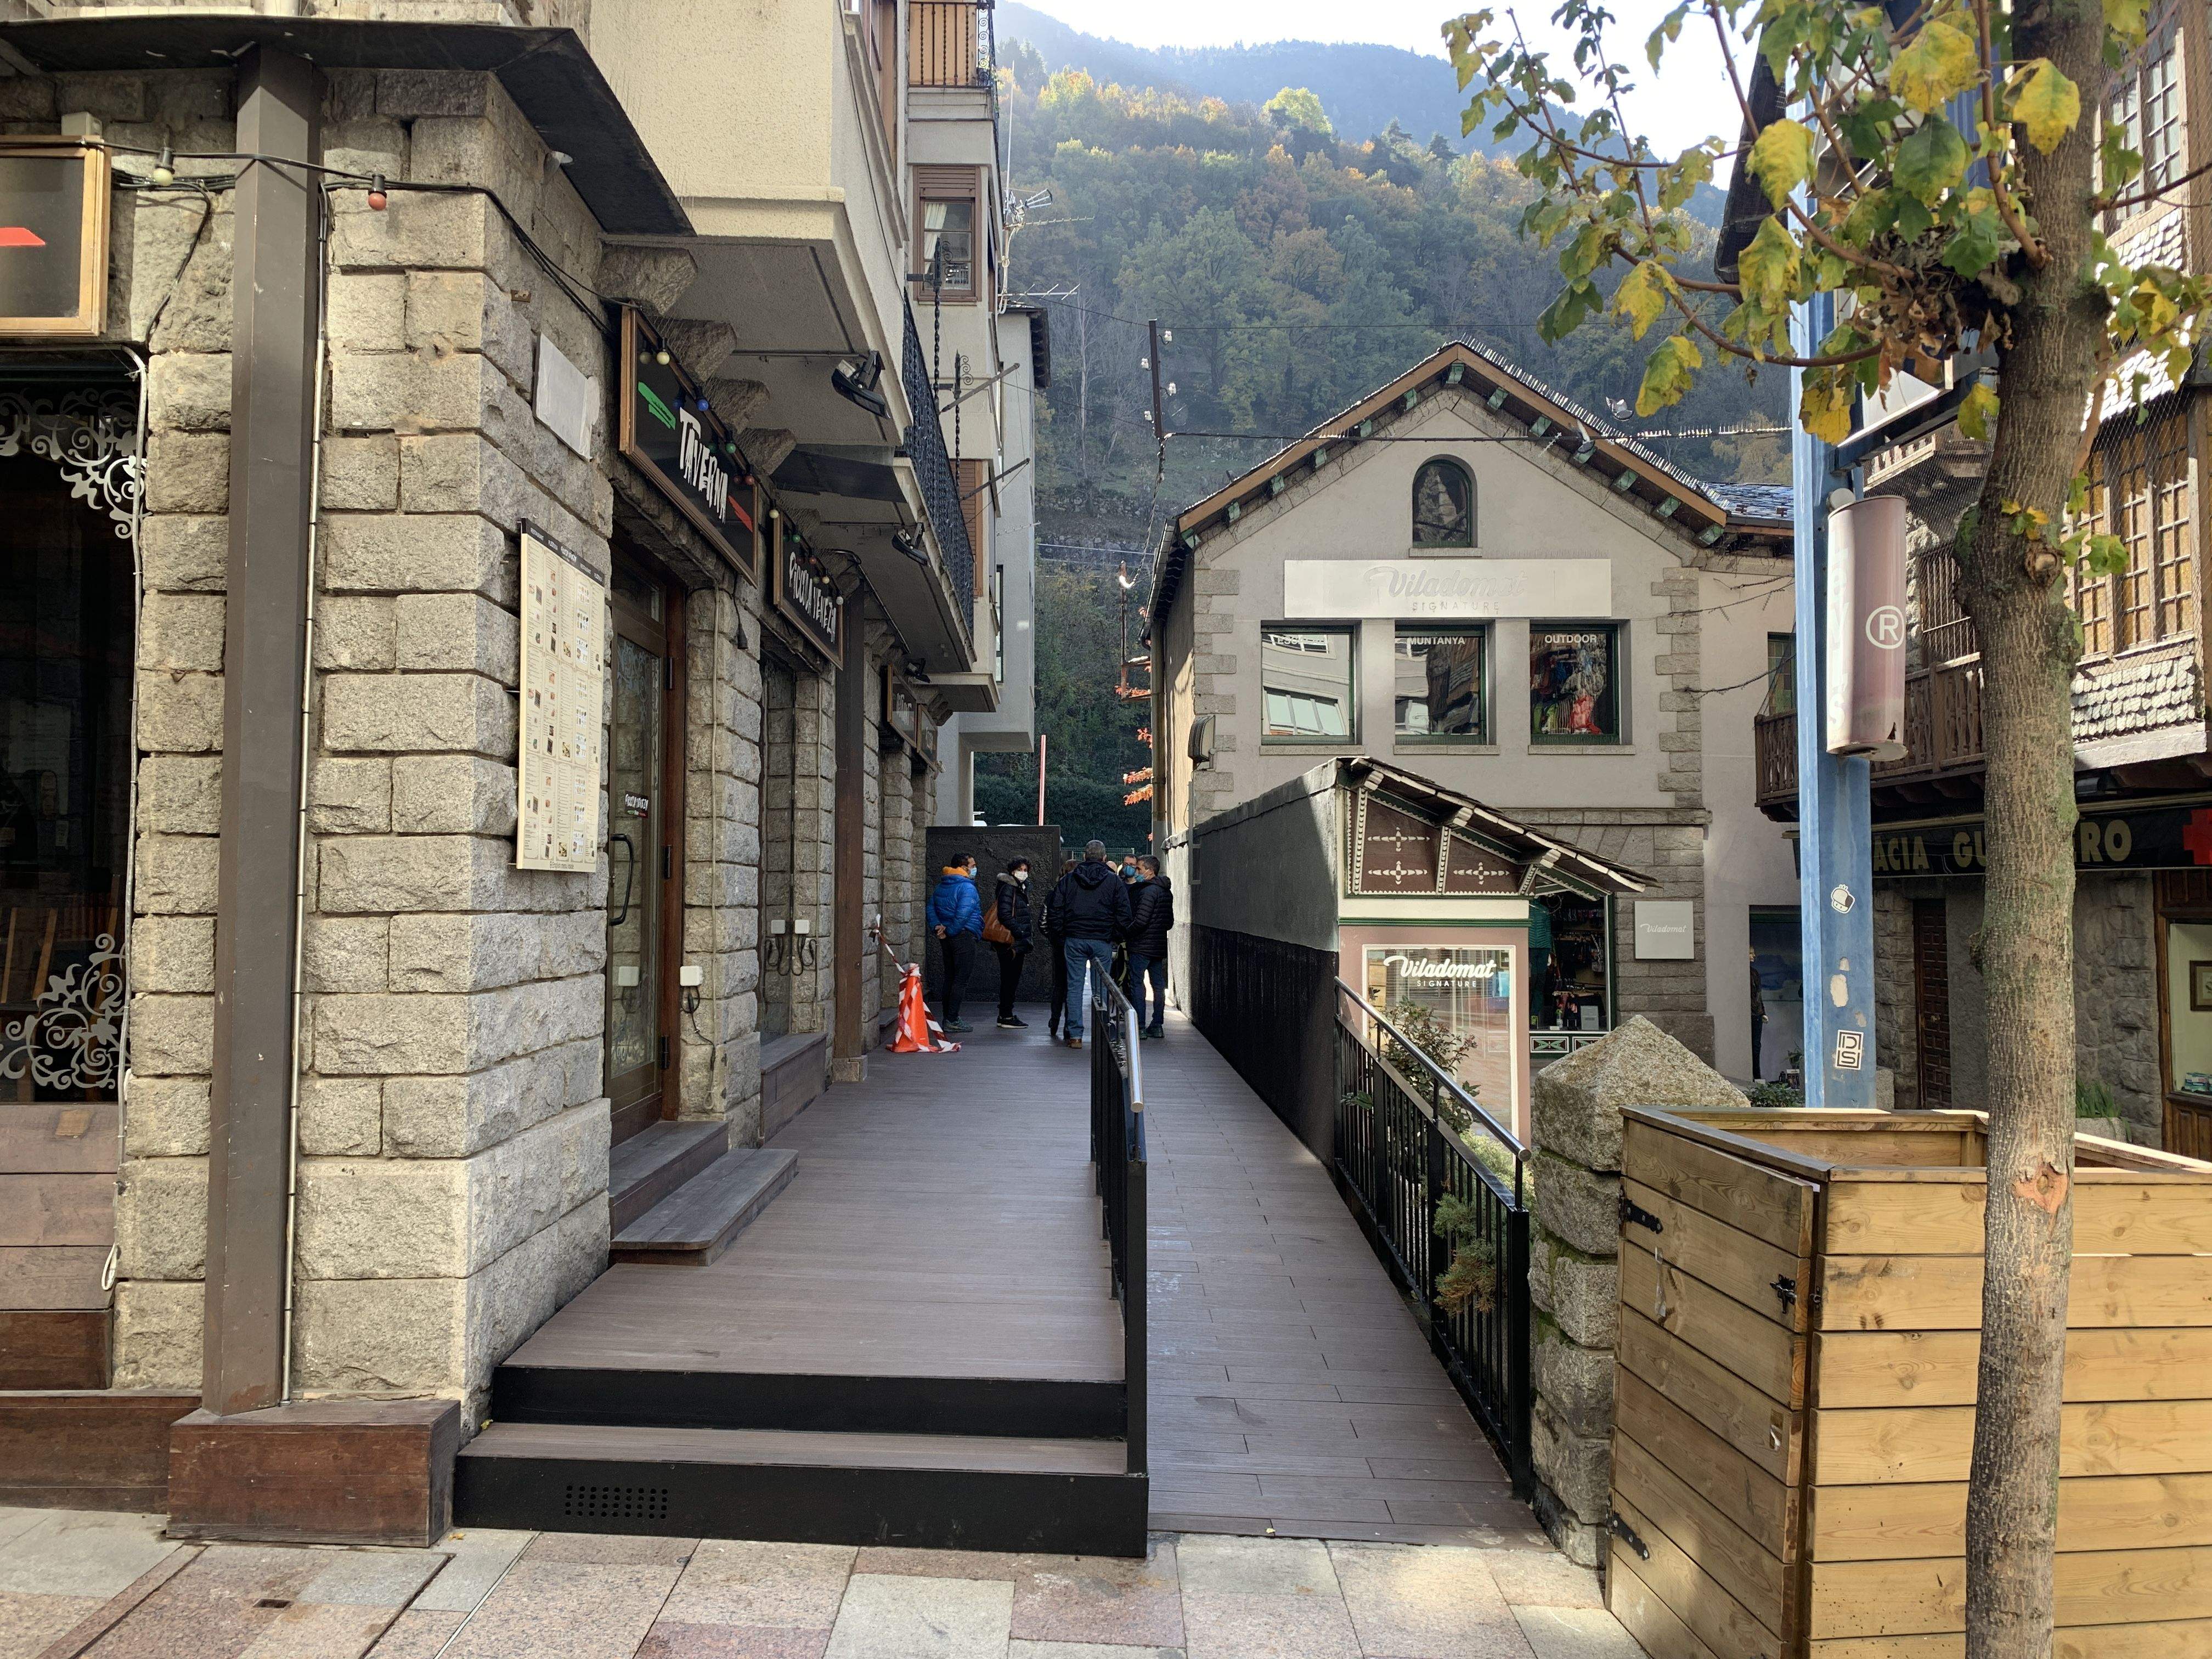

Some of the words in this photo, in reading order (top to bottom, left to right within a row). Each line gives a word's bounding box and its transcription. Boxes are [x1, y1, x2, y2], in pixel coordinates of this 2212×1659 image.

[1364, 566, 1528, 597] Viladomat
[1412, 601, 1500, 611] SIGNATURE
[1408, 636, 1466, 645] MUNTANYA
[1544, 634, 1598, 644] OUTDOOR
[1640, 923, 1686, 933] Viladomat
[1383, 955, 1497, 978] Viladomat
